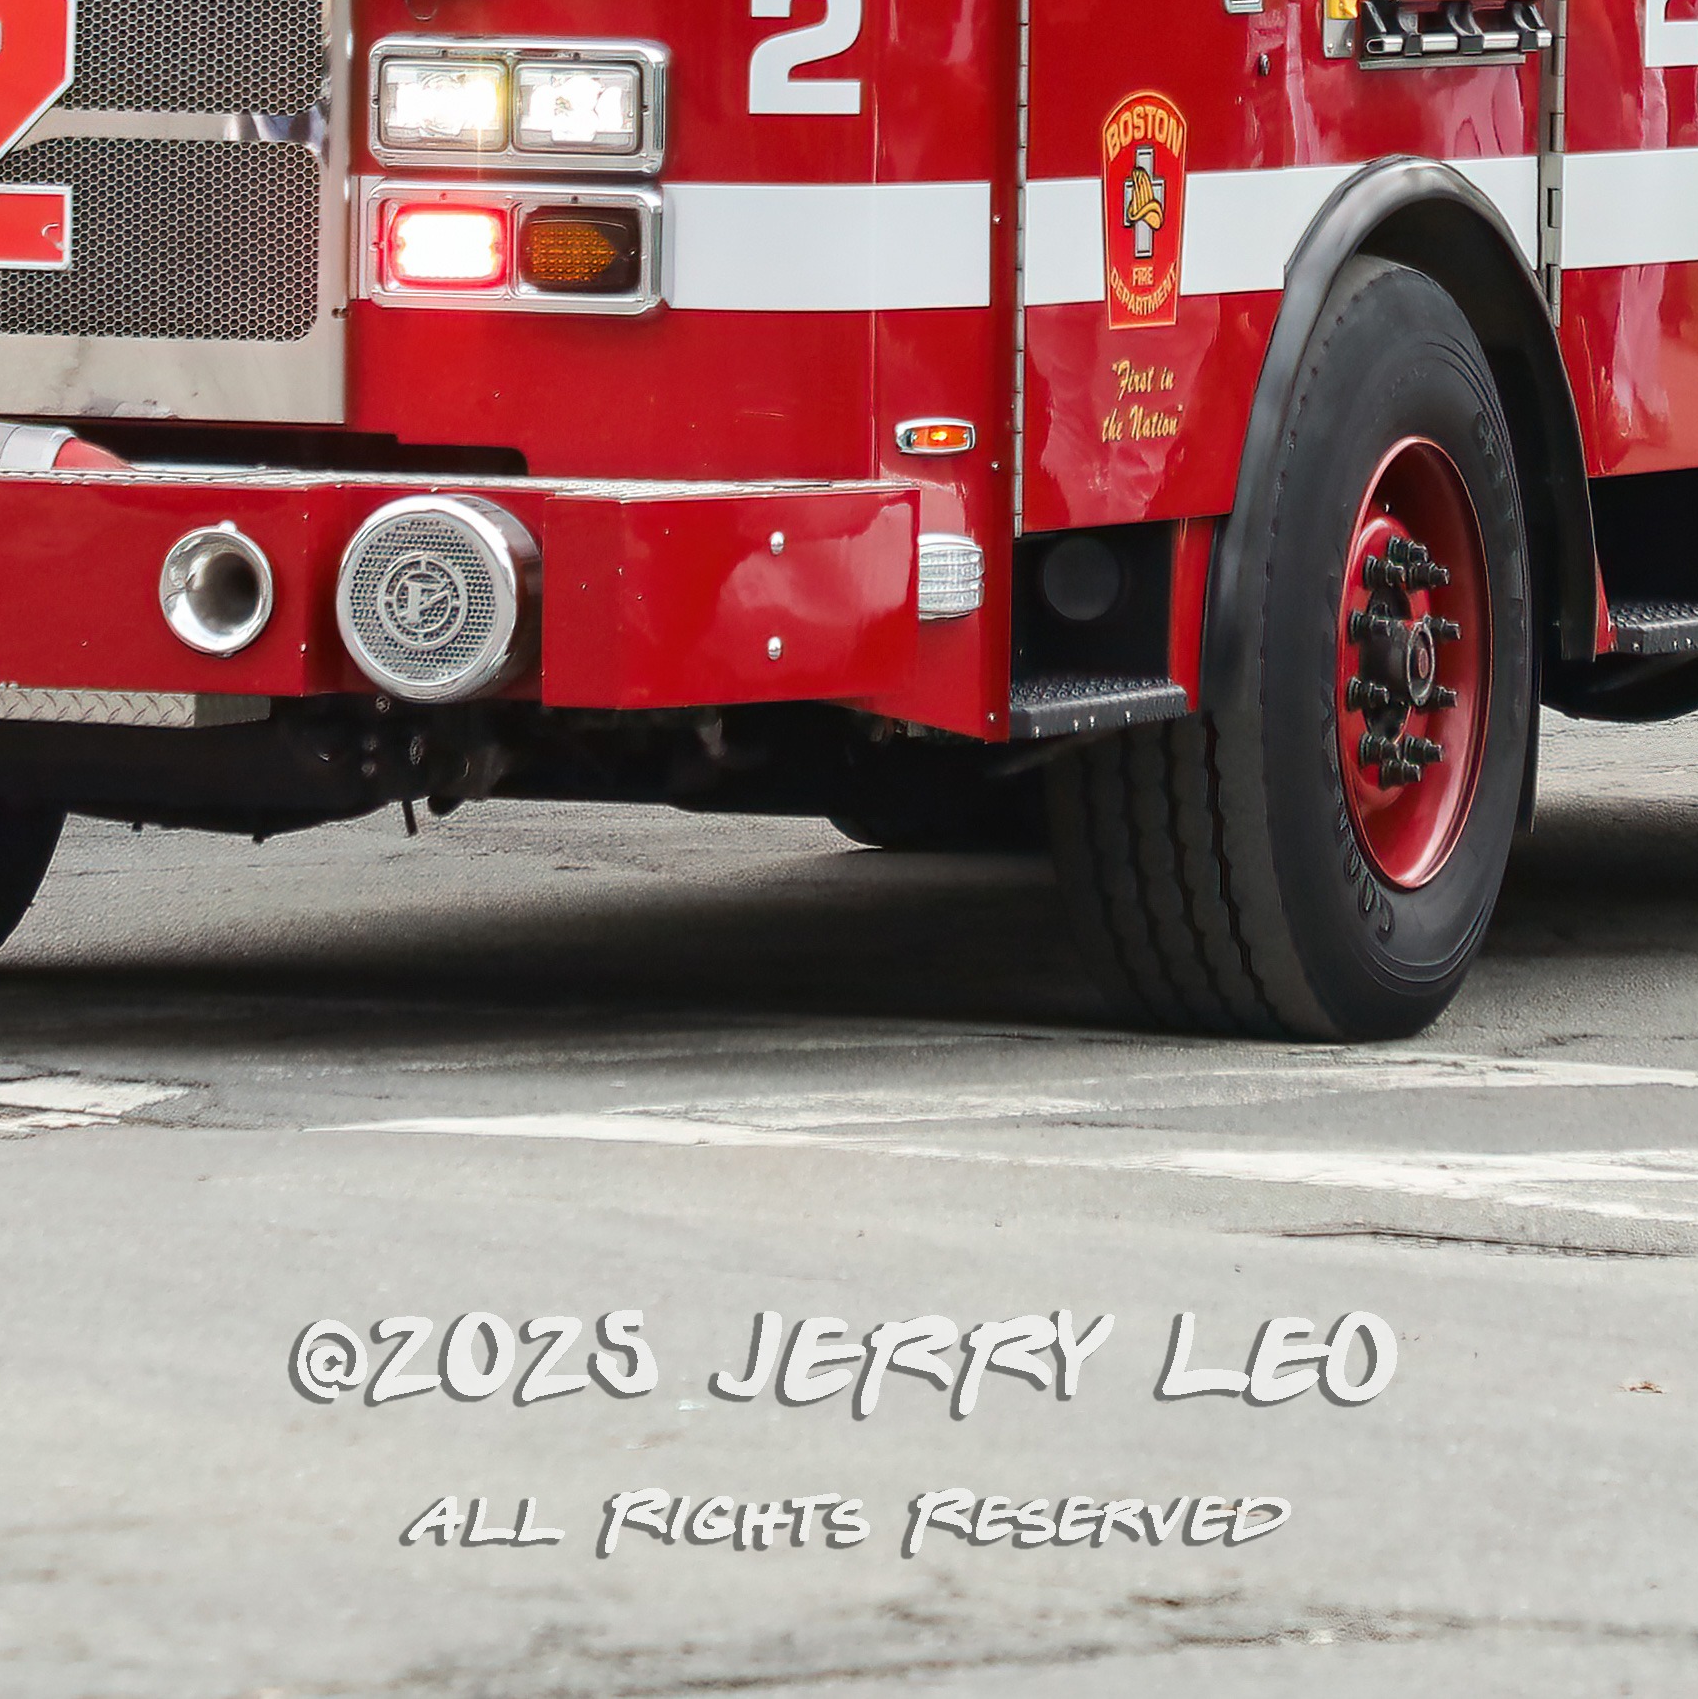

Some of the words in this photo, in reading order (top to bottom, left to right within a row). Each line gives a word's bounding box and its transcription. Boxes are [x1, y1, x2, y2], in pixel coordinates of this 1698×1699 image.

[1105, 105, 1183, 160] BOSTON
[1109, 261, 1177, 316] DEPARTMENT
[1132, 265, 1154, 287] FIRE
[1160, 366, 1175, 392] in
[1101, 409, 1124, 443] the
